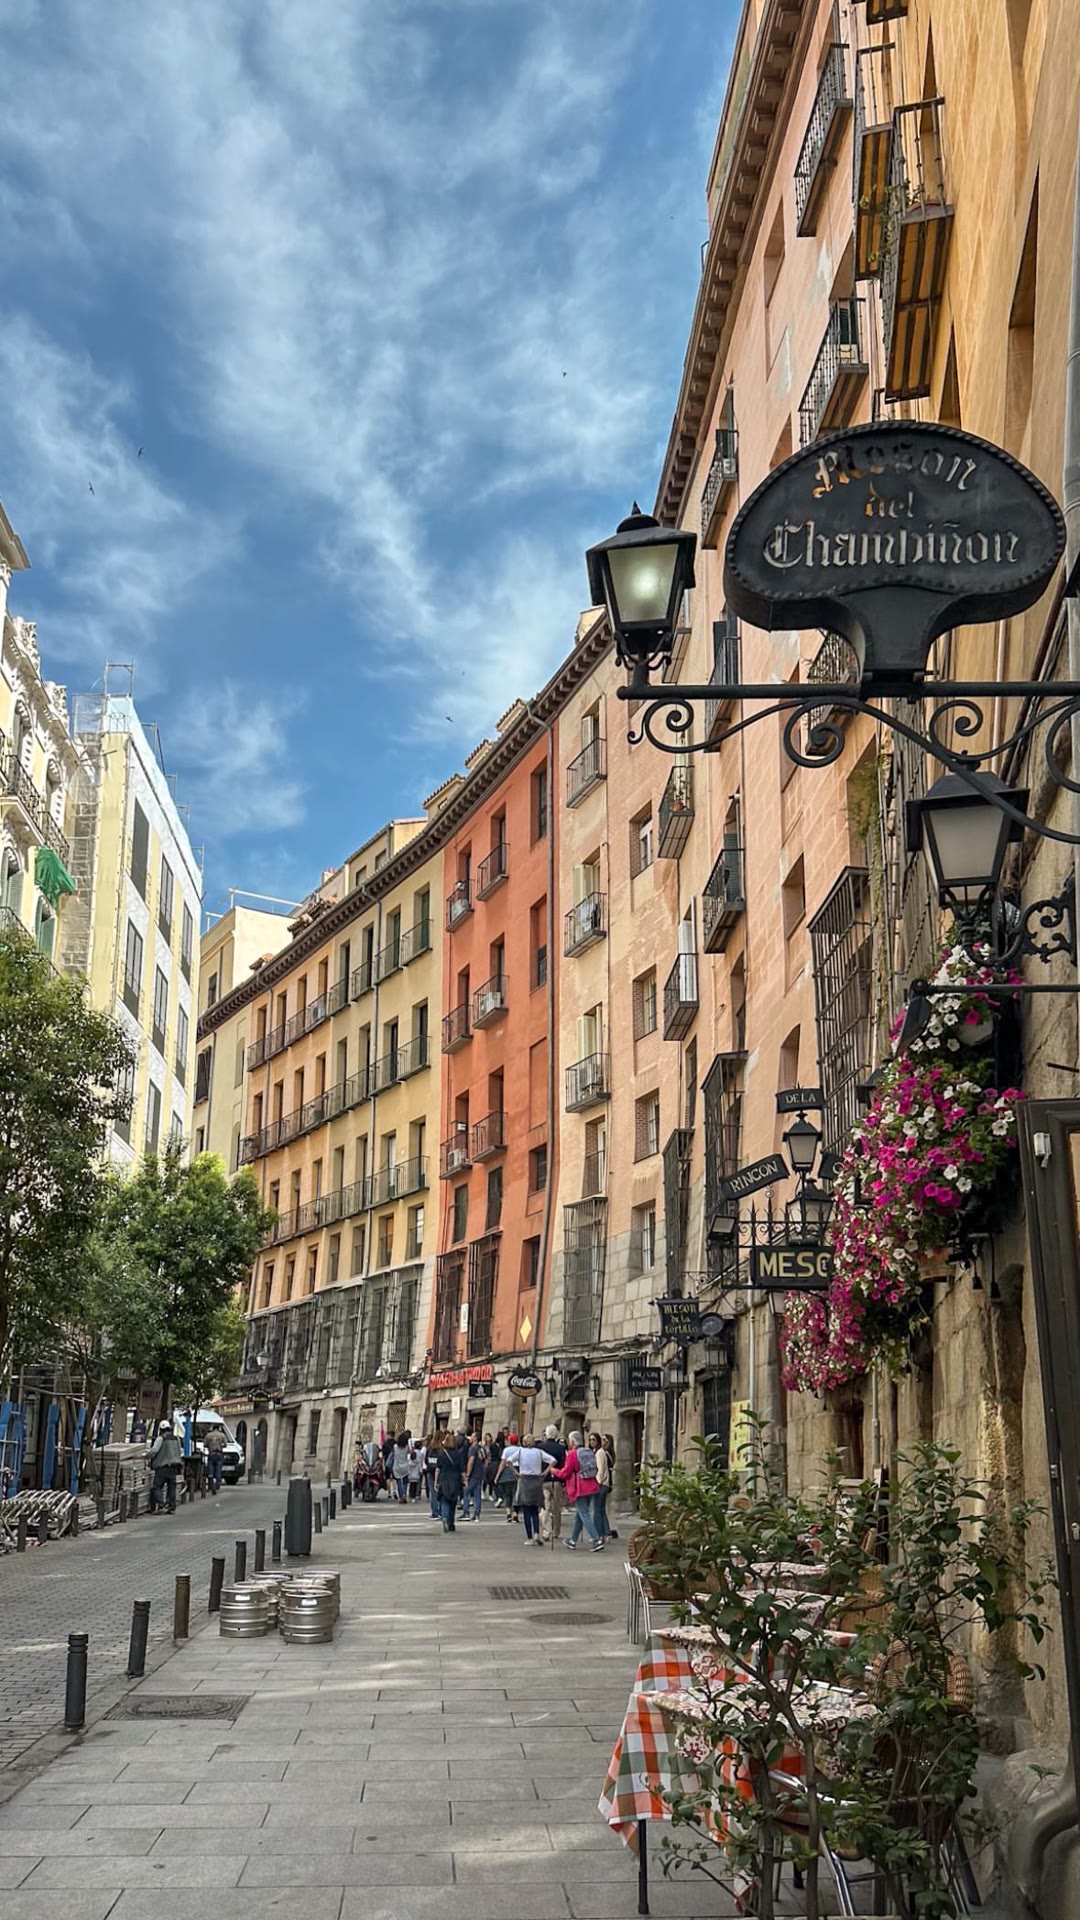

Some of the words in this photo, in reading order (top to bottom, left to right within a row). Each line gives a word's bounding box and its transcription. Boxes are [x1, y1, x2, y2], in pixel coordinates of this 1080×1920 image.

[785, 1092, 799, 1104] DE
[801, 1092, 816, 1103] LA
[730, 1160, 778, 1192] RINCON
[760, 1251, 832, 1278] MESO
